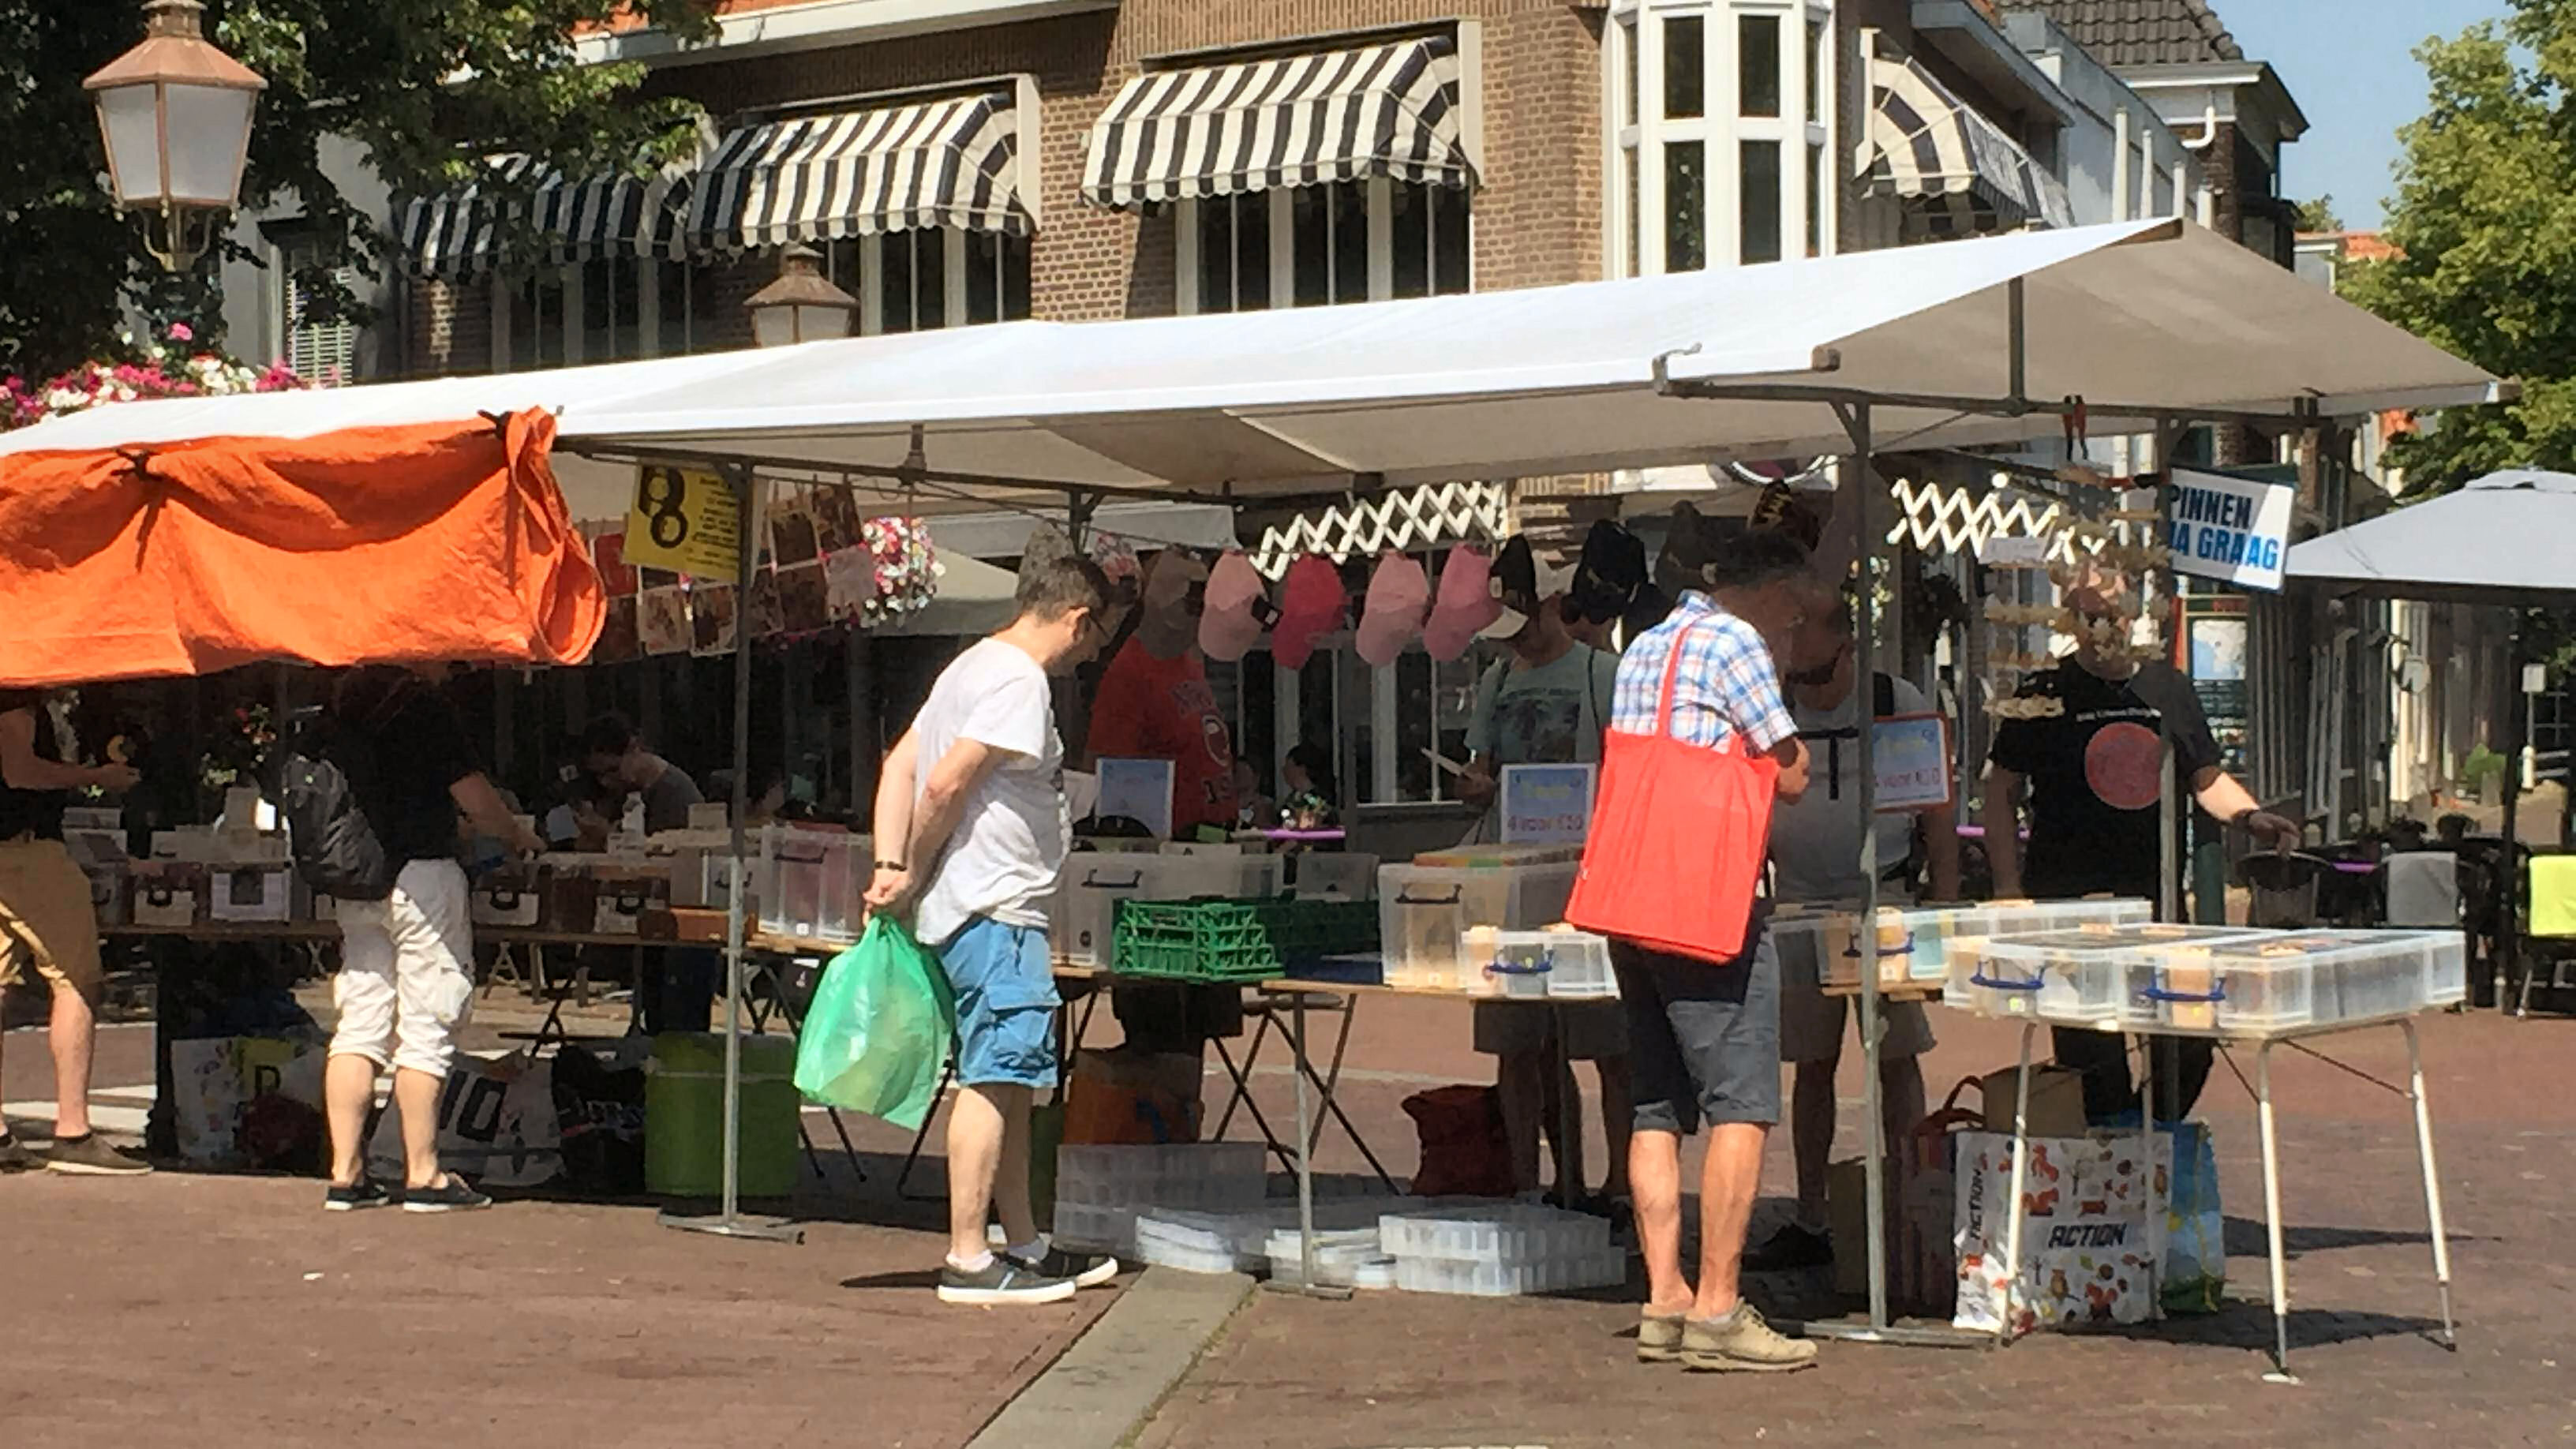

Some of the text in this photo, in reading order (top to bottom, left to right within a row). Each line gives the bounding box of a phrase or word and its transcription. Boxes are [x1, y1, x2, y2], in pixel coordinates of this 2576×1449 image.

[2170, 485, 2252, 530] PINNEN
[2197, 526, 2279, 571] GRAAG
[1968, 1168, 1983, 1240] ACTION
[2049, 1223, 2127, 1249] ACTION
